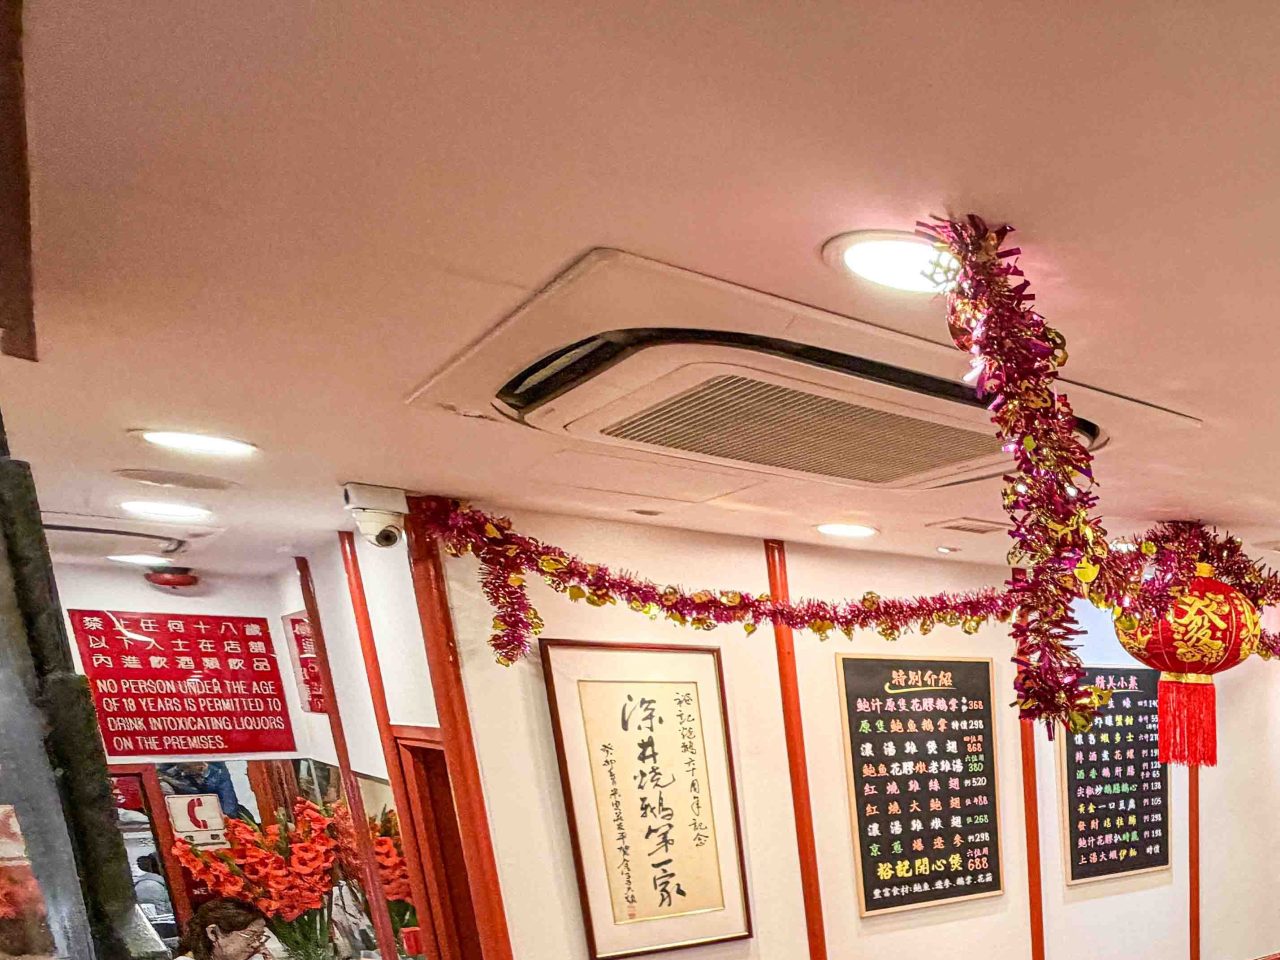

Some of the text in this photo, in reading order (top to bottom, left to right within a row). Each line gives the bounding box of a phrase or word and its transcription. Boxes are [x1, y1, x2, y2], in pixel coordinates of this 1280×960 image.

[891, 669, 953, 687] 特別介紹
[97, 678, 276, 694] NO PERSON UNDER THE AGE
[102, 698, 281, 712] OF 18 YEARS IS PERMITTED TO
[968, 700, 984, 710] 368
[107, 716, 284, 731] DRINK INTOXICATING LIQUORS
[968, 720, 984, 729] 298
[113, 736, 228, 751] ON THE PREMISES.
[967, 743, 982, 752] 868
[968, 762, 983, 772] 380
[972, 777, 987, 787] 520
[974, 815, 989, 824] 268
[975, 832, 990, 842] 298
[968, 857, 989, 870] 688
